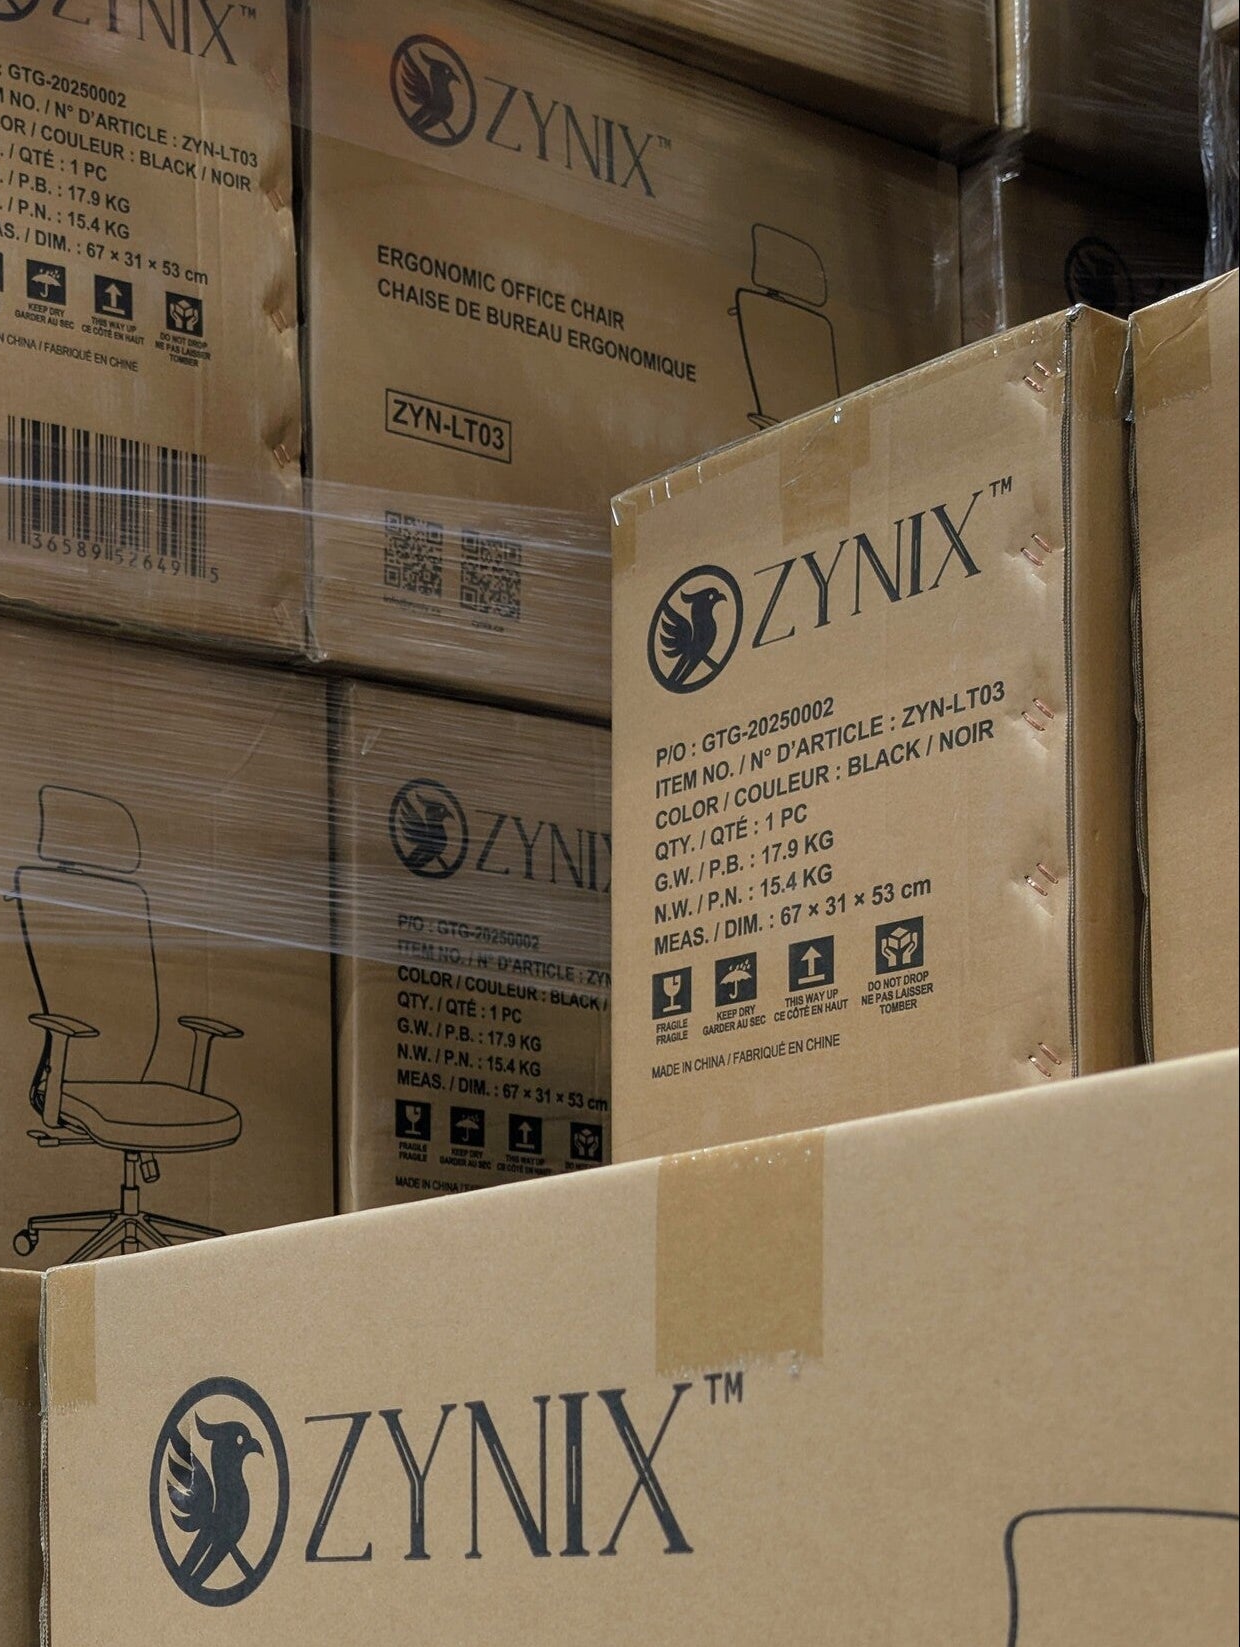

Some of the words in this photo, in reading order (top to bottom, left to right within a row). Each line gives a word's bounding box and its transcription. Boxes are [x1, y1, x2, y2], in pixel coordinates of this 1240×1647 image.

[8, 64, 126, 108] GTG-20250002
[10, 90, 40, 112] NO.
[182, 136, 258, 168] ZYN-LT03
[378, 245, 495, 292] ERGONOMIC
[501, 279, 566, 313] OFFICE
[571, 299, 624, 330] CHAIR
[378, 278, 450, 312] CHAISE
[456, 298, 481, 321] DE
[486, 306, 562, 342] BUREAU
[568, 329, 696, 382] ERGONOMIQUE
[392, 399, 505, 451] ZYN-LT03
[656, 743, 686, 767] P/O
[702, 697, 834, 752] GTG-20250002
[656, 770, 697, 798] ITEM
[703, 761, 734, 785] NO.
[901, 681, 1005, 728] ZYN-LT03
[656, 796, 719, 829] COLOR
[734, 765, 829, 807] COULEUR
[848, 738, 920, 776] BLACK
[940, 720, 994, 752] NOIR
[655, 834, 695, 860] QTY.
[710, 816, 748, 845] QTÉ
[765, 812, 773, 830] 1
[781, 804, 807, 828] PC
[655, 866, 694, 892] G.W.
[710, 854, 744, 878] P.B.
[762, 839, 798, 864] 17.9
[805, 830, 834, 854] KG
[654, 899, 692, 924] N.W.
[708, 886, 742, 911] P.N.
[760, 872, 797, 897] 15.4
[803, 864, 832, 888] KG
[397, 991, 433, 1010] QTY.
[446, 999, 476, 1017] QTÉ
[490, 1005, 496, 1020] 1
[502, 1007, 522, 1024] PC
[652, 1063, 680, 1078] MADE
[682, 1061, 692, 1073] IN
[694, 1055, 726, 1071] CHINA
[733, 1043, 786, 1064] FABRIQUÉ
[788, 1040, 803, 1054] EN
[806, 1034, 840, 1051] CHINE
